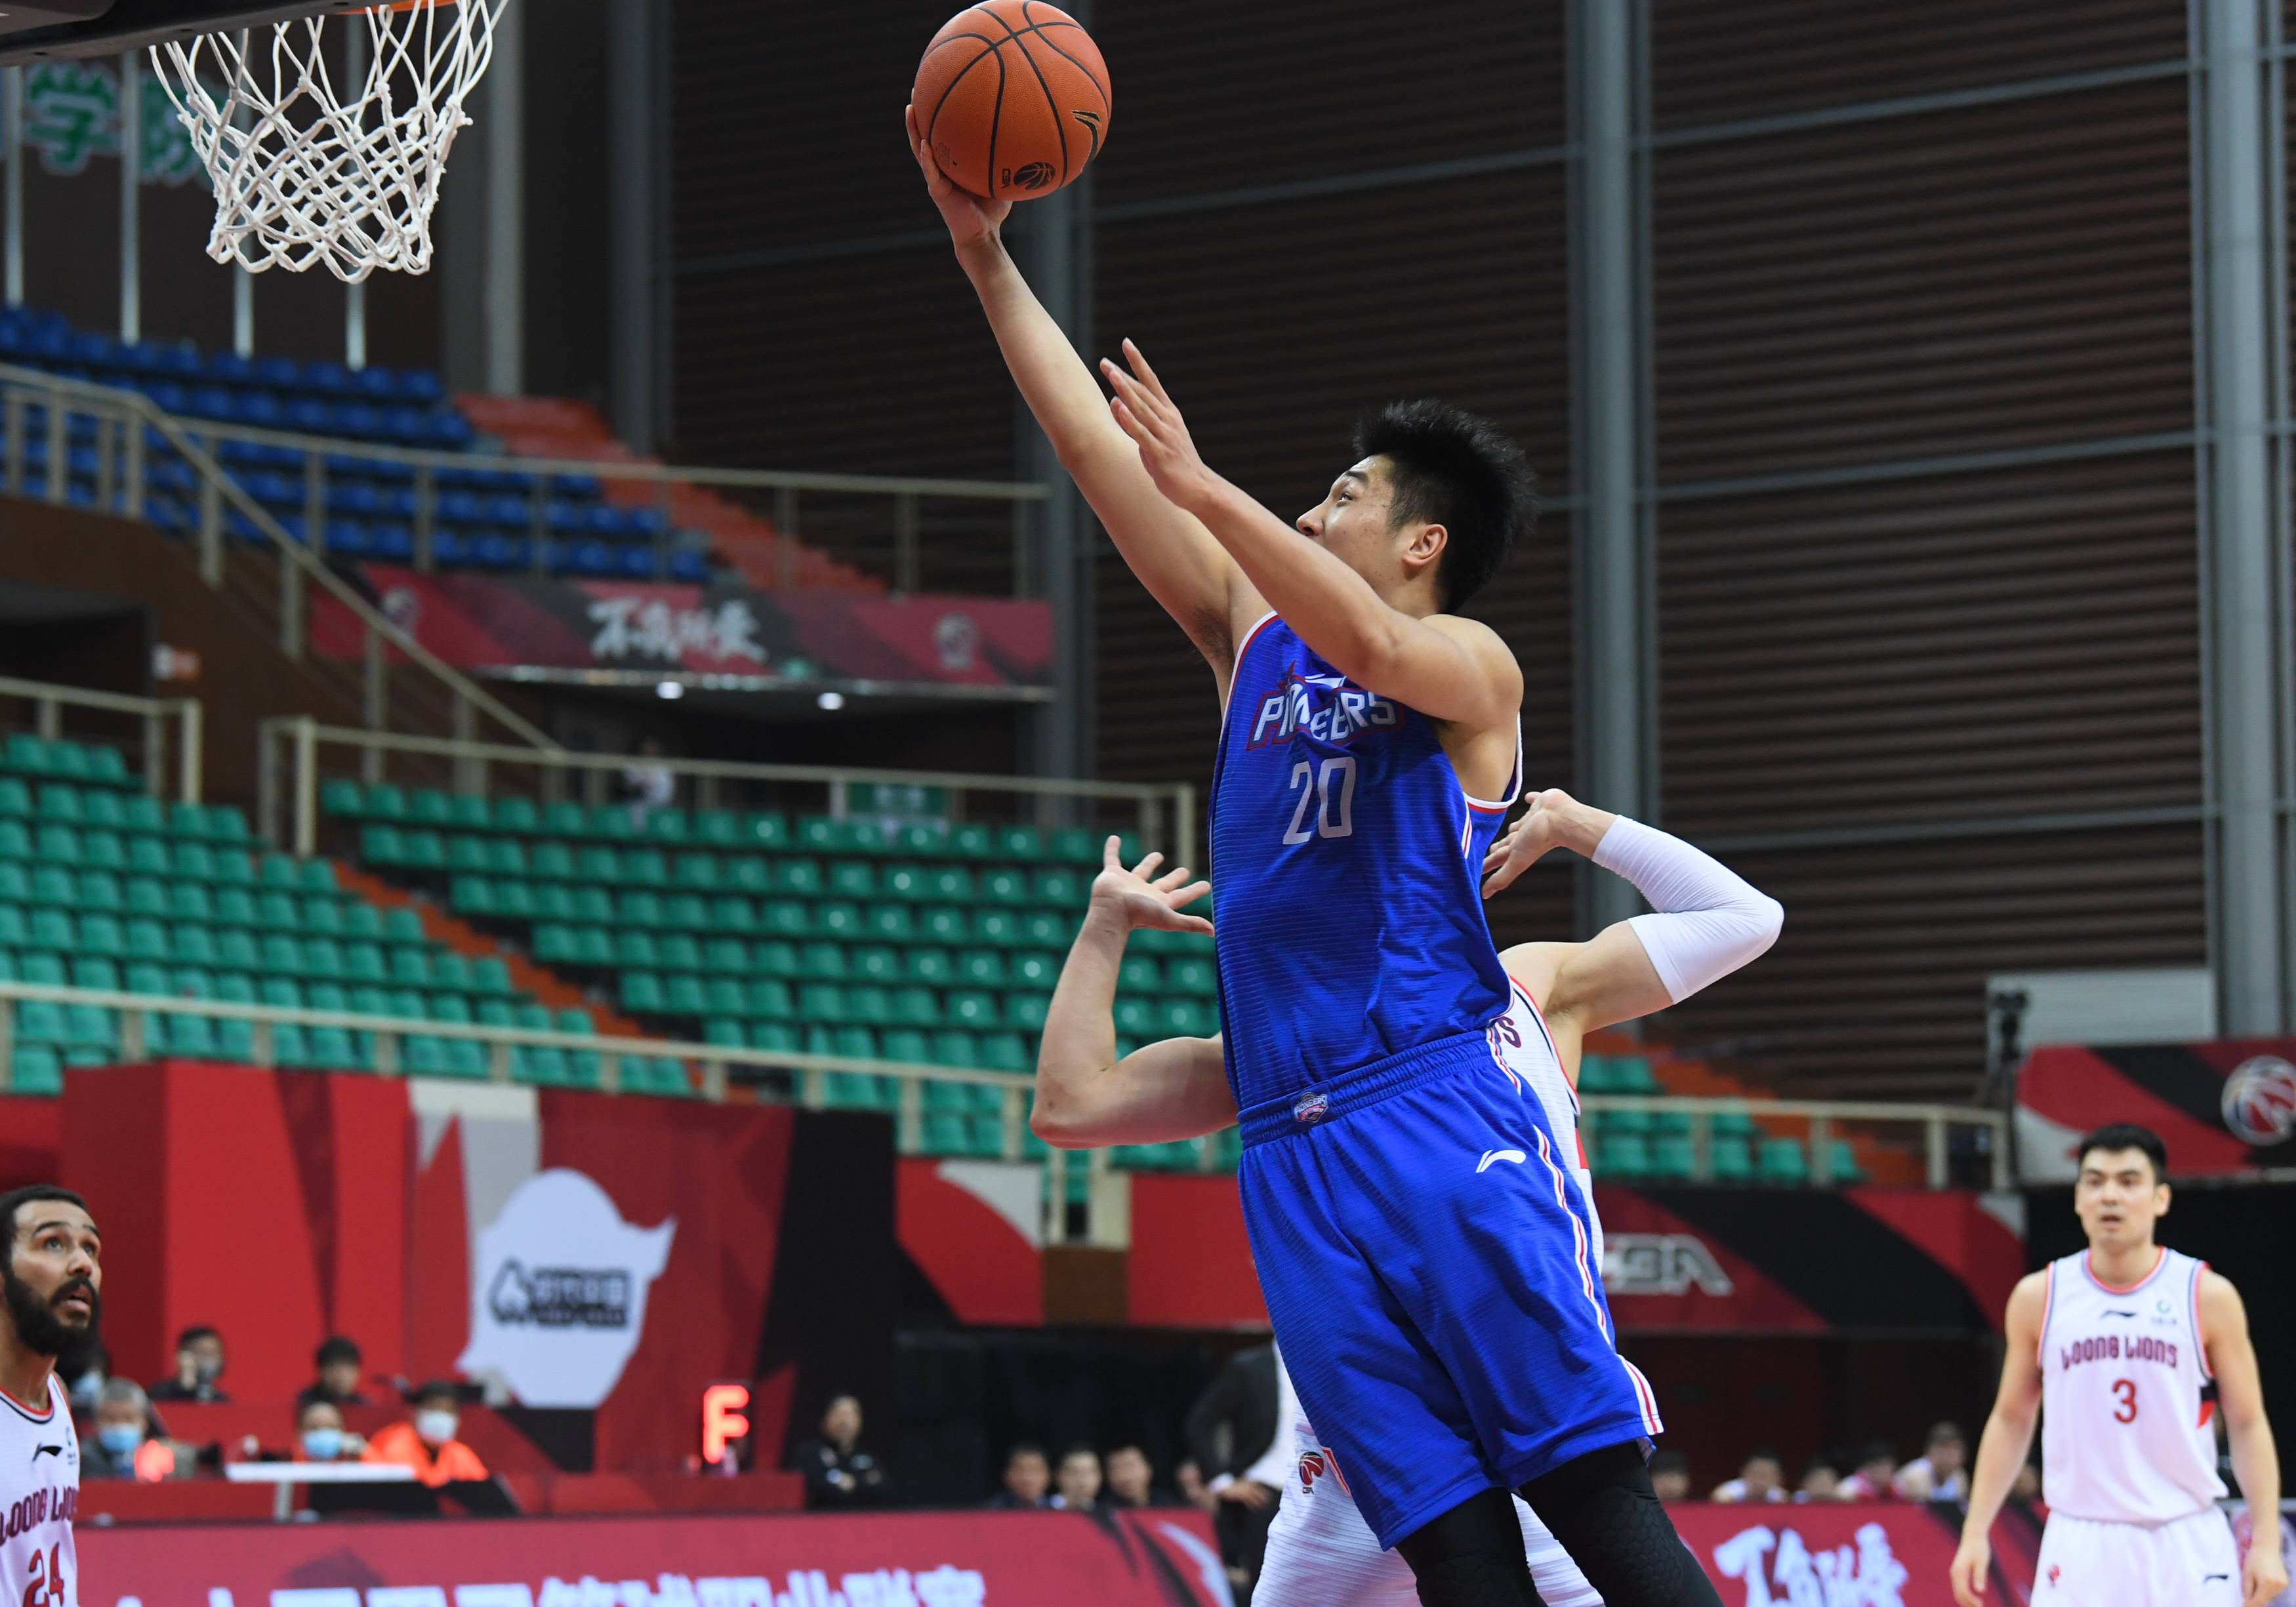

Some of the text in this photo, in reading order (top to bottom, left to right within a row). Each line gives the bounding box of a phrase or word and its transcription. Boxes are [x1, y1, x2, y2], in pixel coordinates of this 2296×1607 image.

[1282, 756, 1357, 845] 20
[2125, 1335, 2178, 1368] LIONS
[703, 1385, 750, 1463] F
[2112, 1379, 2137, 1423] 3
[23, 1541, 64, 1607] 24
